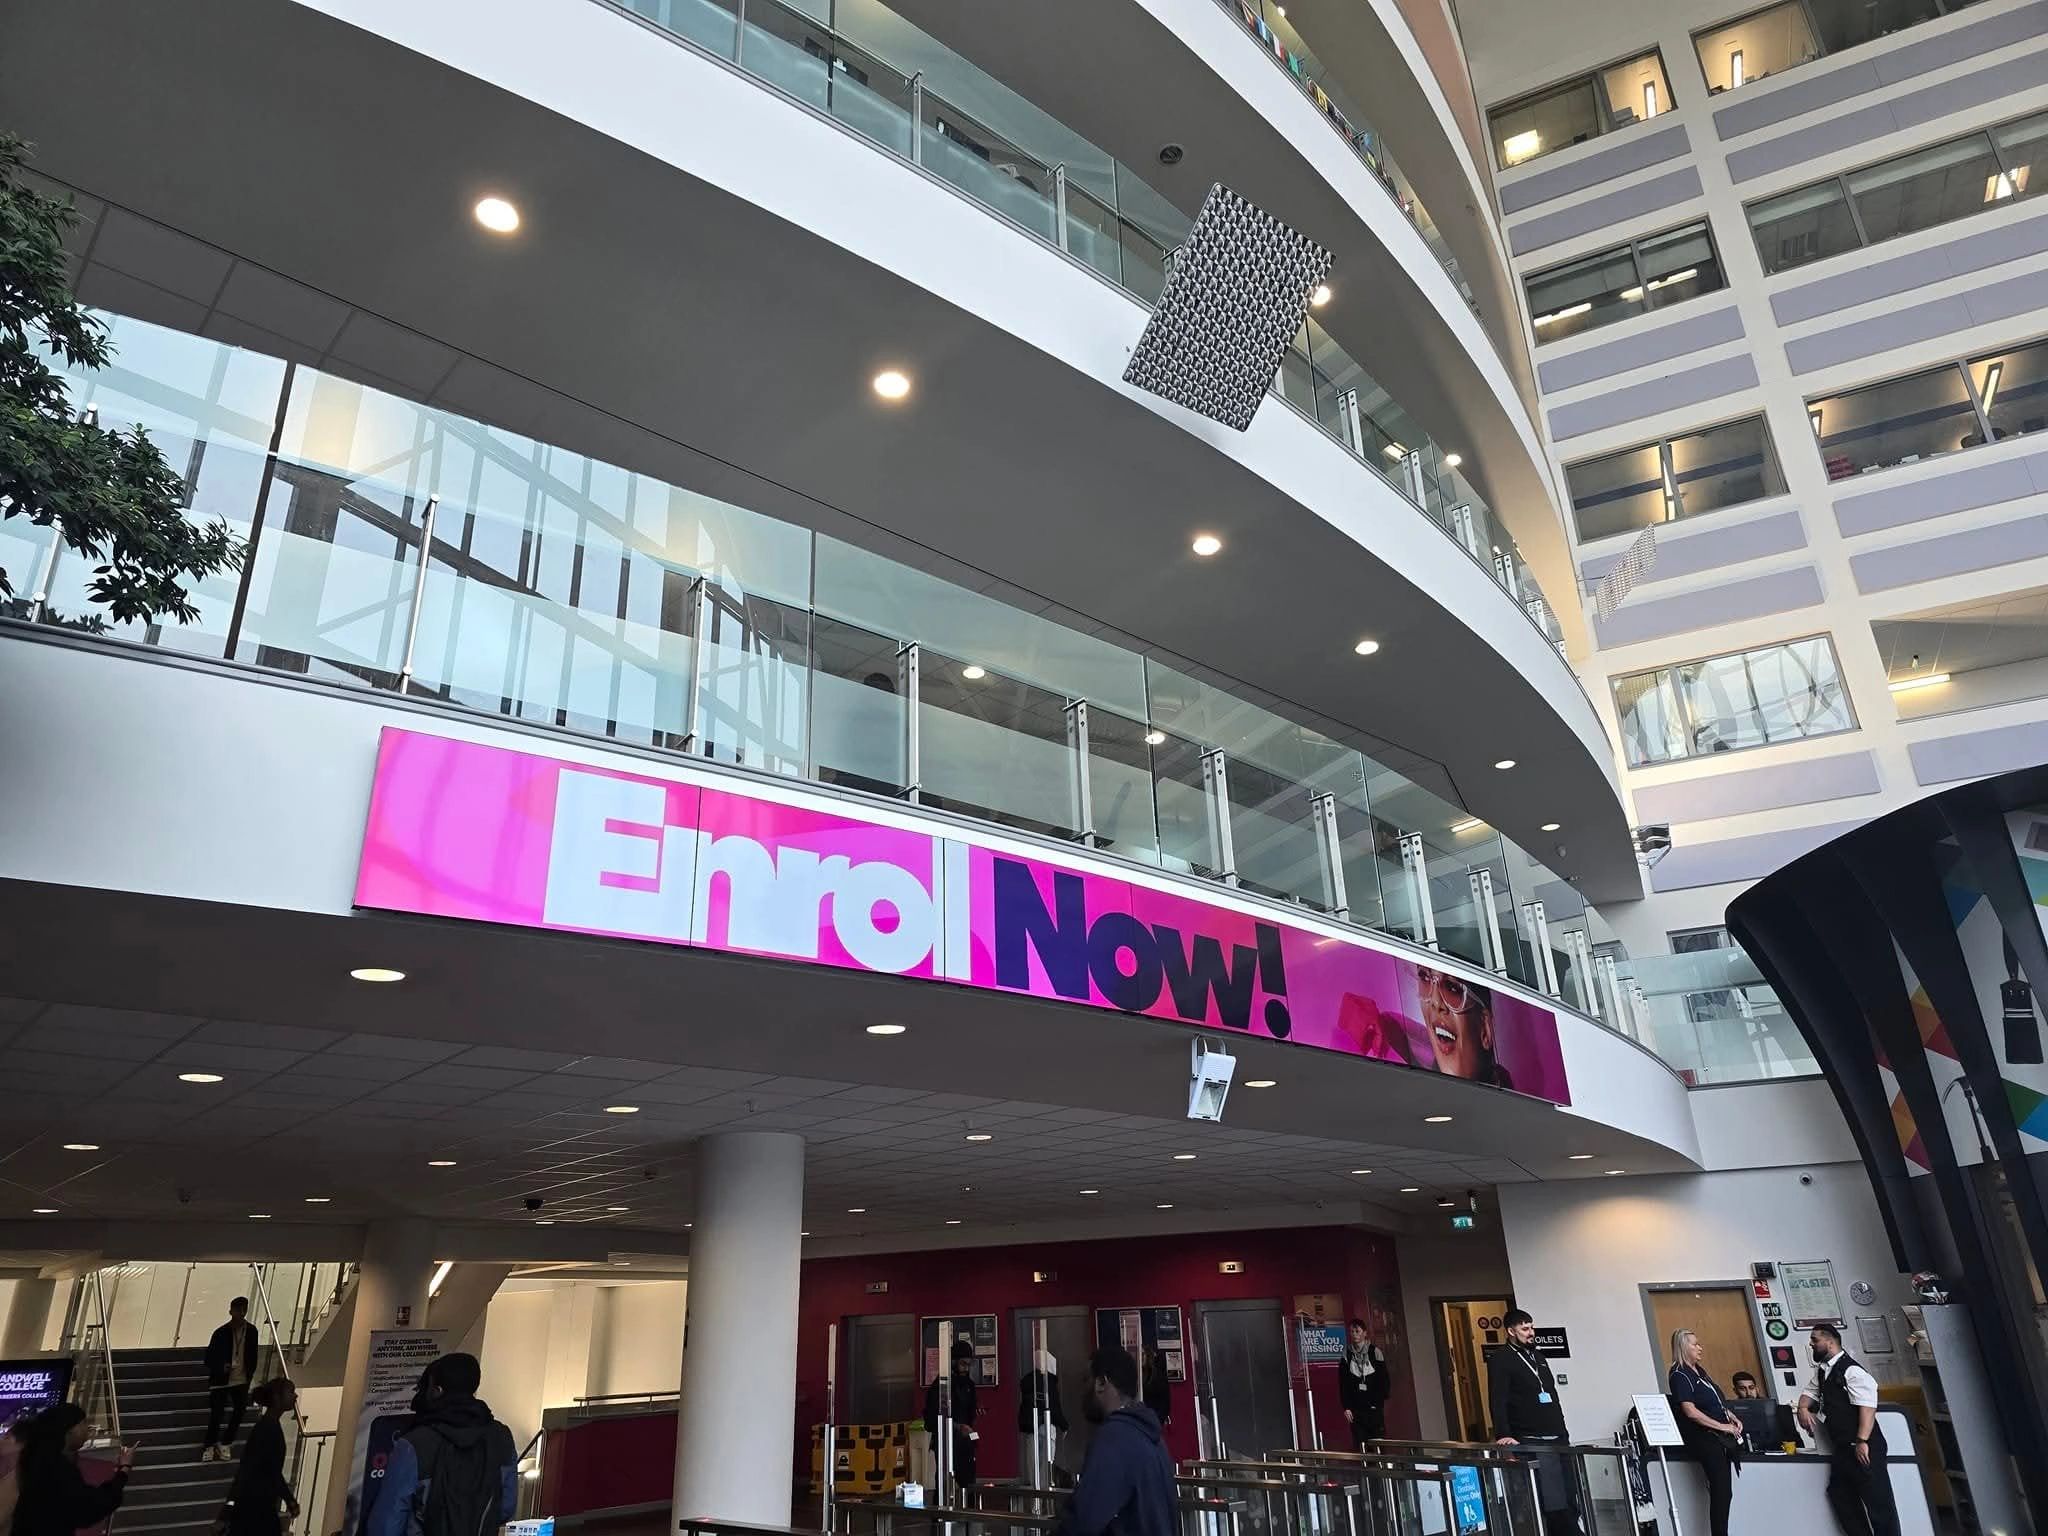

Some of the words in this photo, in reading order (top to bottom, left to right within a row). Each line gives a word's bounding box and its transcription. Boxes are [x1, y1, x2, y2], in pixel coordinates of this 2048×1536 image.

[542, 767, 971, 982] Enrol
[994, 856, 1291, 1039] Now!
[1300, 1330, 1326, 1338] WHAT
[1301, 1337, 1320, 1345] ARE
[1321, 1337, 1340, 1345] YOU
[1534, 1335, 1564, 1344] OILETS
[1301, 1345, 1344, 1353] MISSING?
[0, 1373, 51, 1382] ANDWELL
